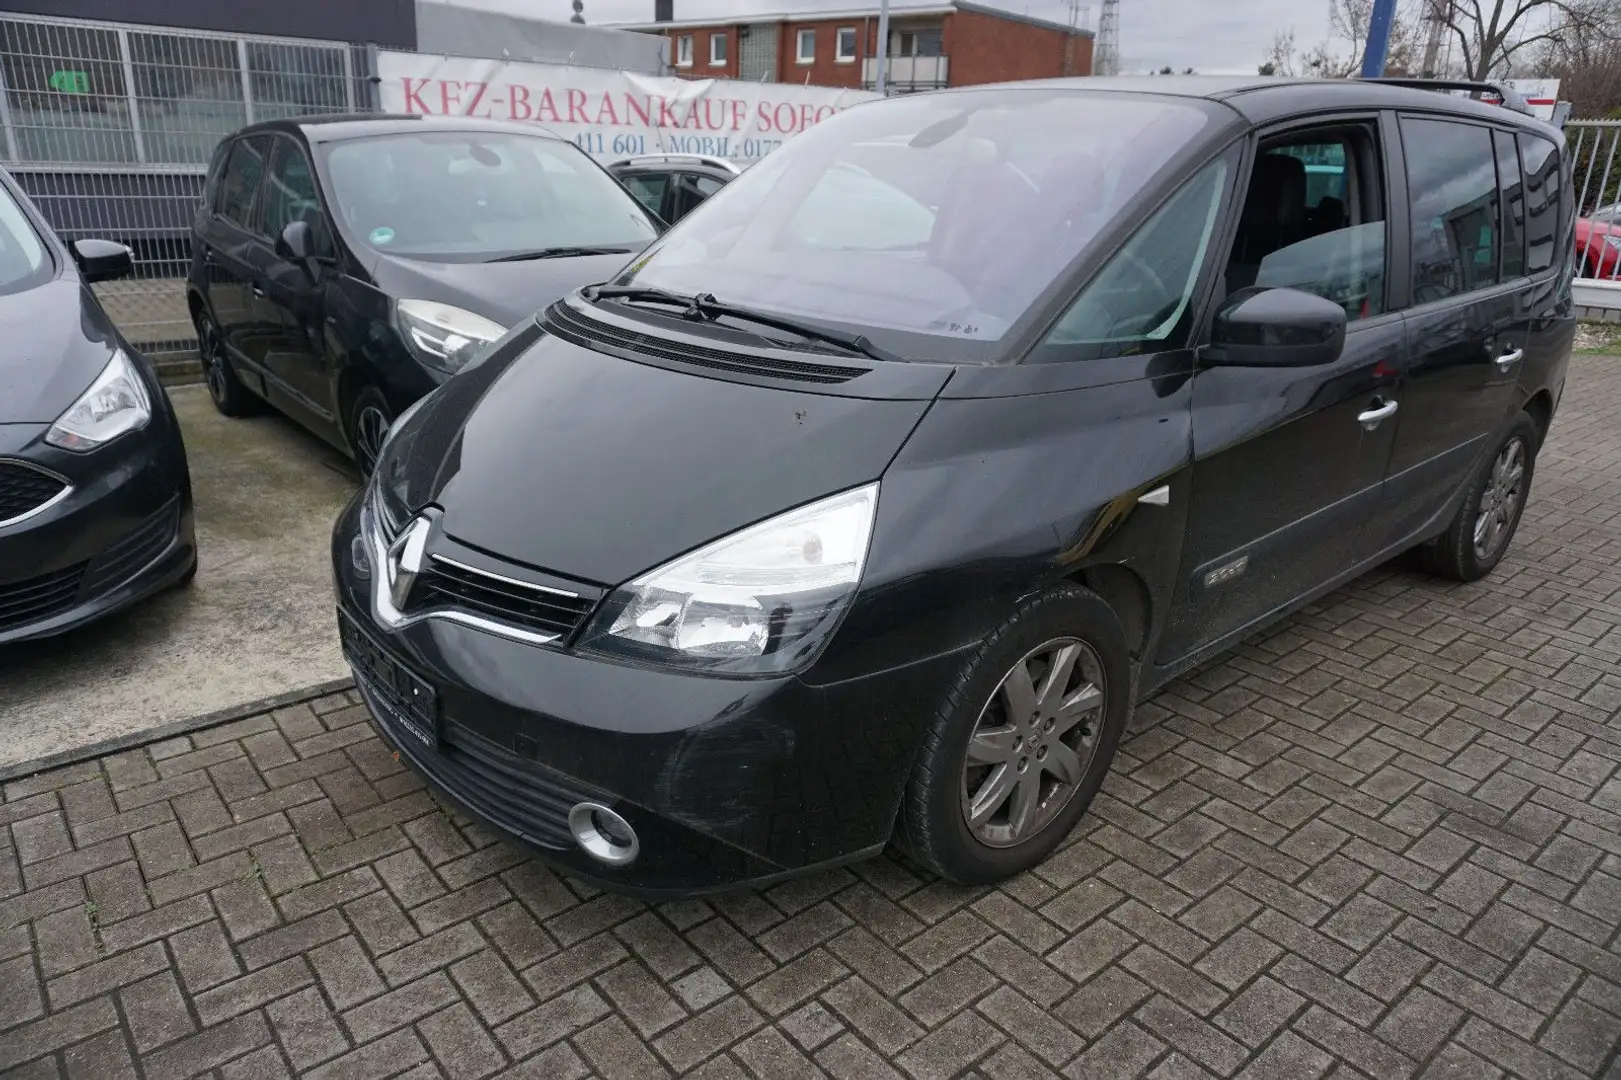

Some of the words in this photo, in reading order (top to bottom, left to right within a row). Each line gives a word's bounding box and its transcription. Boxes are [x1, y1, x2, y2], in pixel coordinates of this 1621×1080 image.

[400, 77, 747, 131] KFZ-BARANKAUF
[757, 101, 848, 133] SOFO
[613, 134, 646, 155] 601
